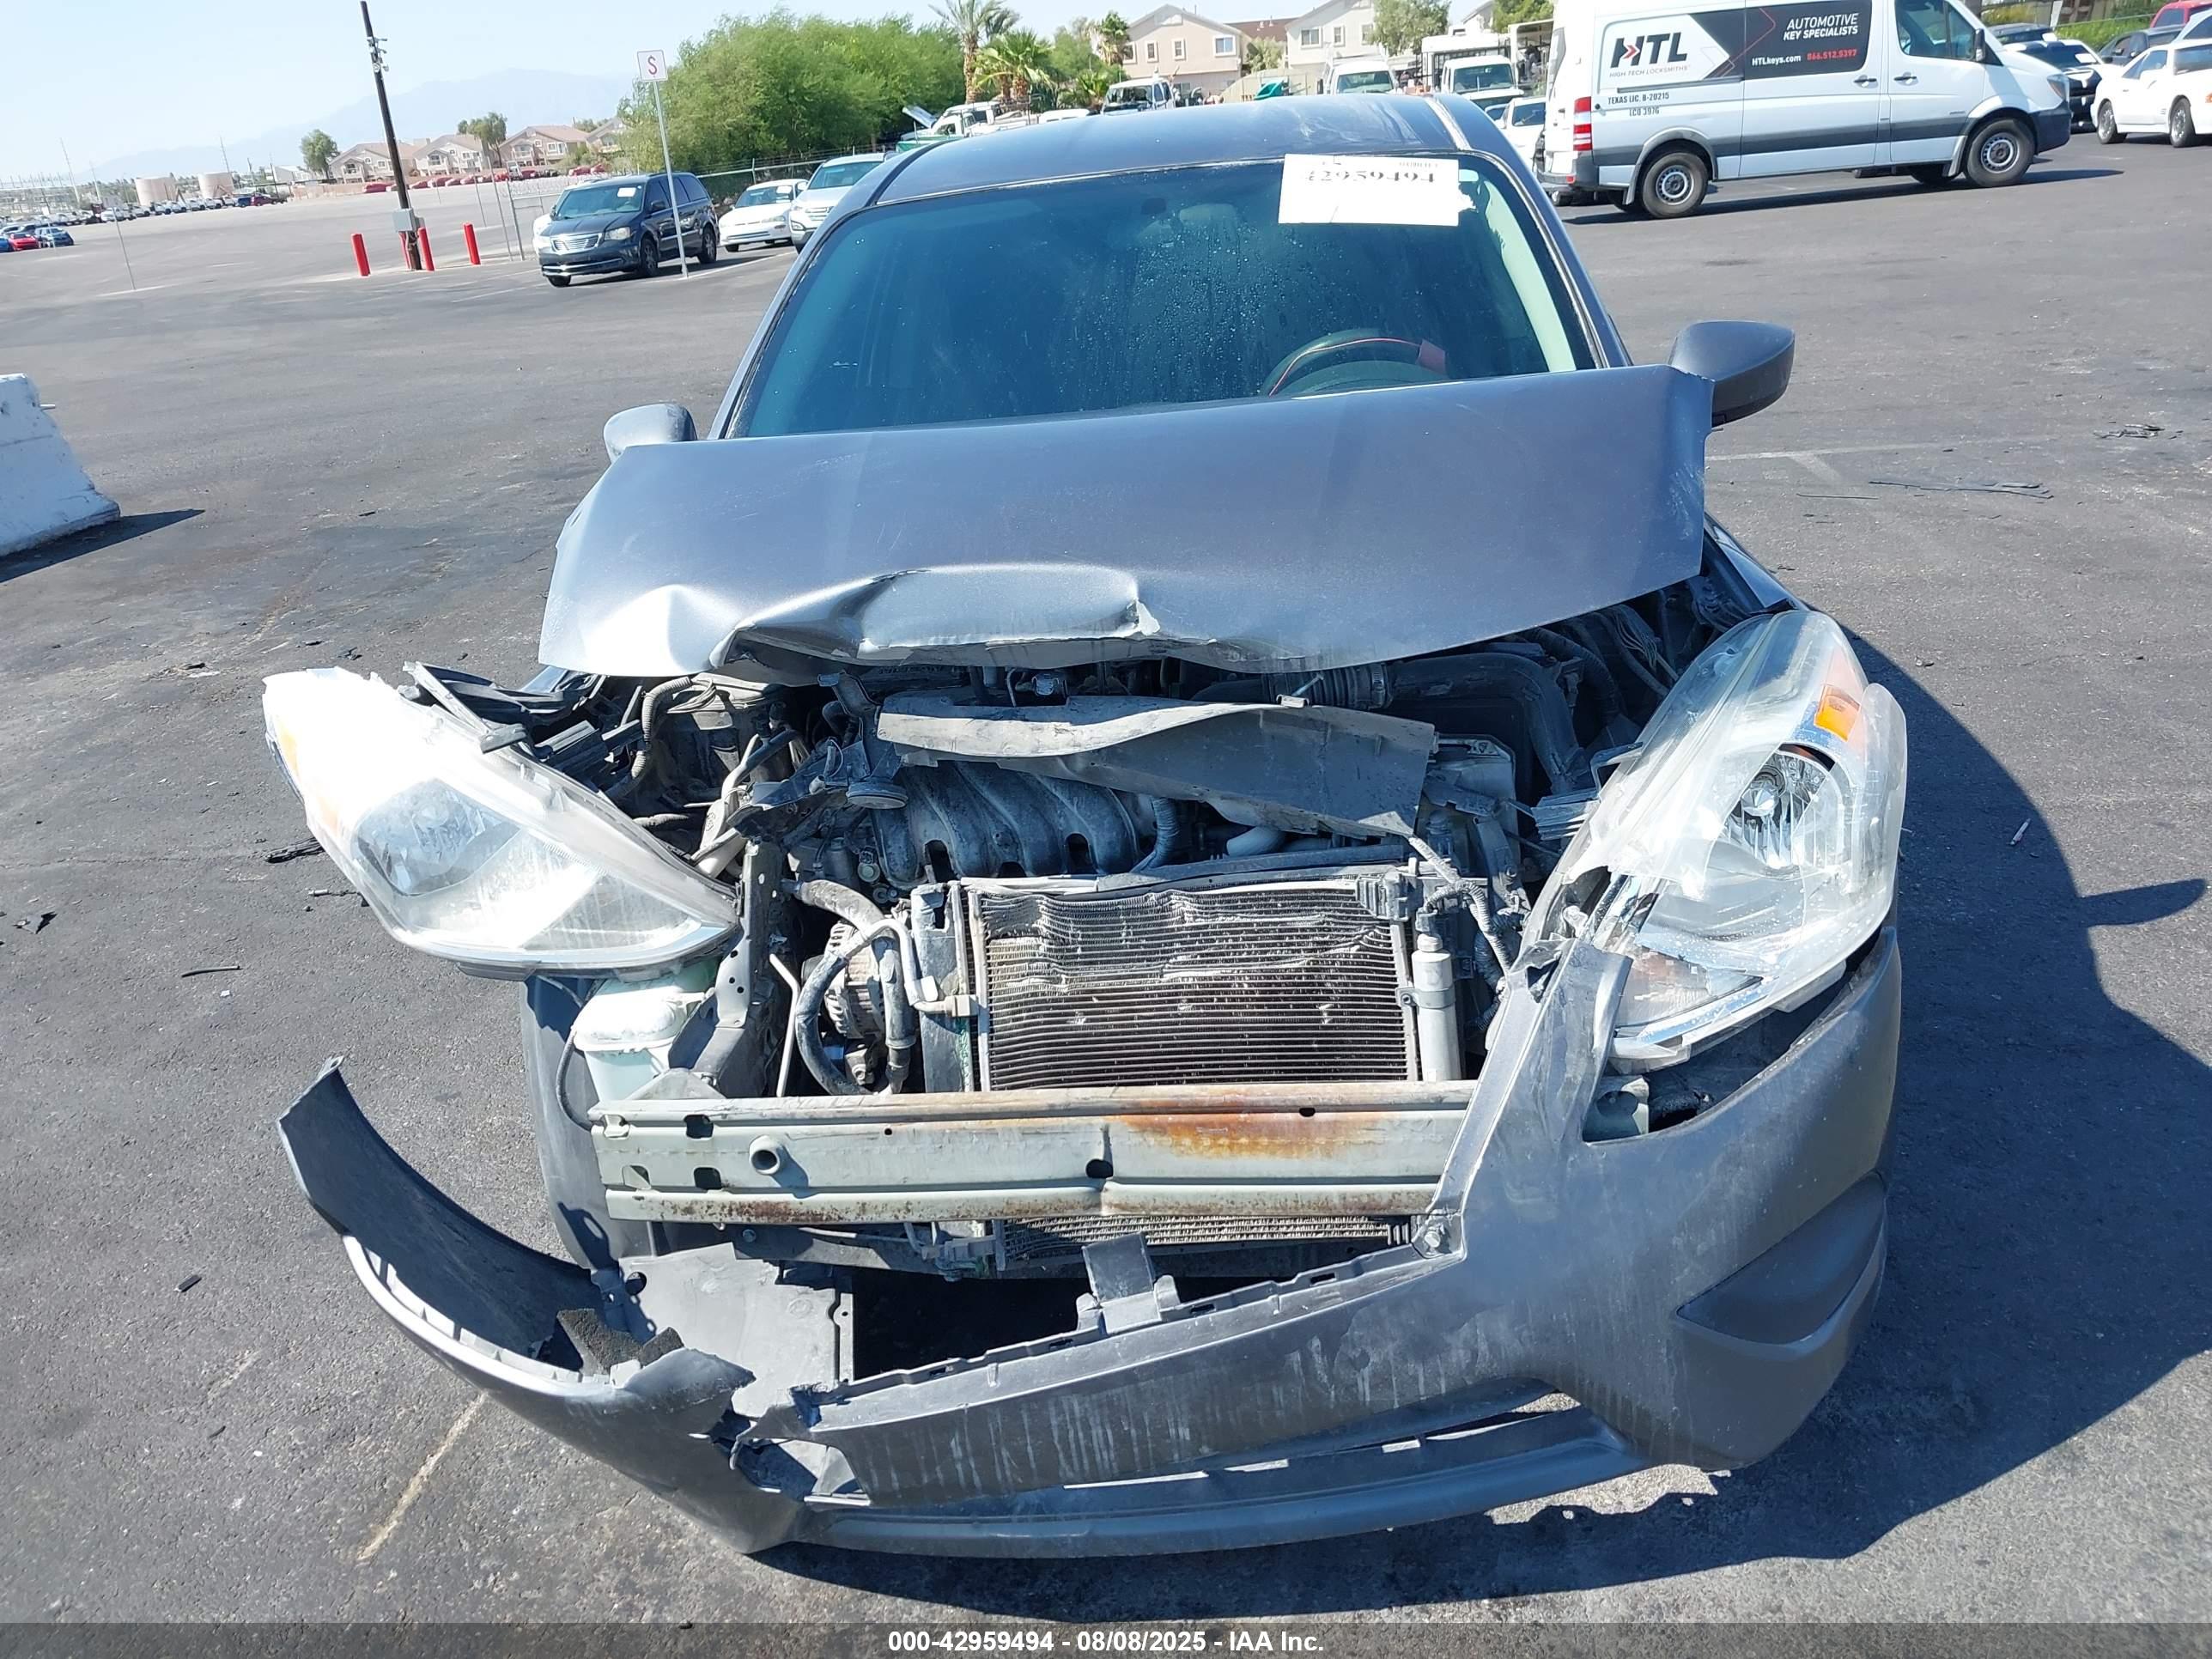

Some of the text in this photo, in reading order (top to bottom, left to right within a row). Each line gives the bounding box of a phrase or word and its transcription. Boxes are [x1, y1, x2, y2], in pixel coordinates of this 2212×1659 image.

[1786, 12, 1859, 31] AUTOMOTIVE
[1783, 25, 1858, 41] KEY SPECIALISTS
[1610, 32, 1687, 68] HTL
[1752, 54, 1802, 66] HTLkeys.com
[1607, 95, 1628, 105] TEXAS
[1629, 94, 1641, 103] LIC.
